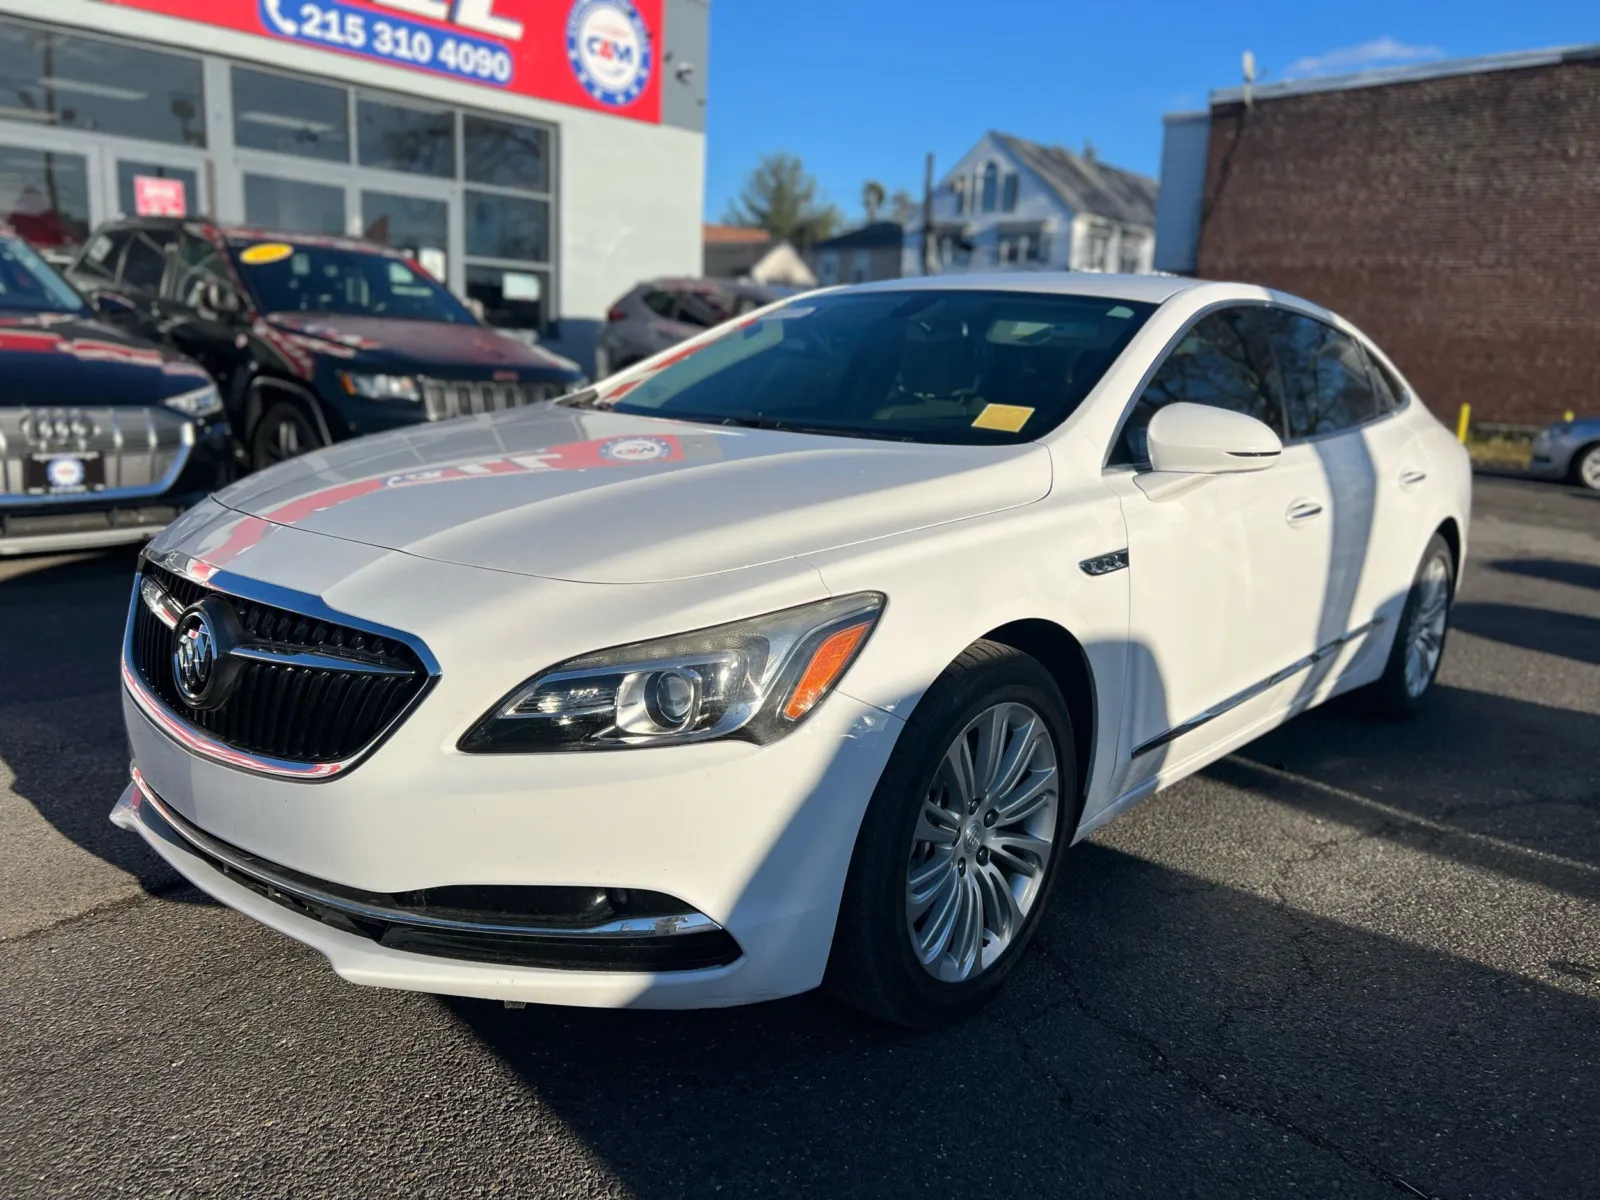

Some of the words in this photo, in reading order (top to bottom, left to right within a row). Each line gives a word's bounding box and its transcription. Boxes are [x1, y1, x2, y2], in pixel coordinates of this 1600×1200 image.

[300, 3, 366, 48] 215
[373, 21, 433, 64] 310
[438, 38, 511, 82] 4090
[586, 35, 633, 65] C&M
